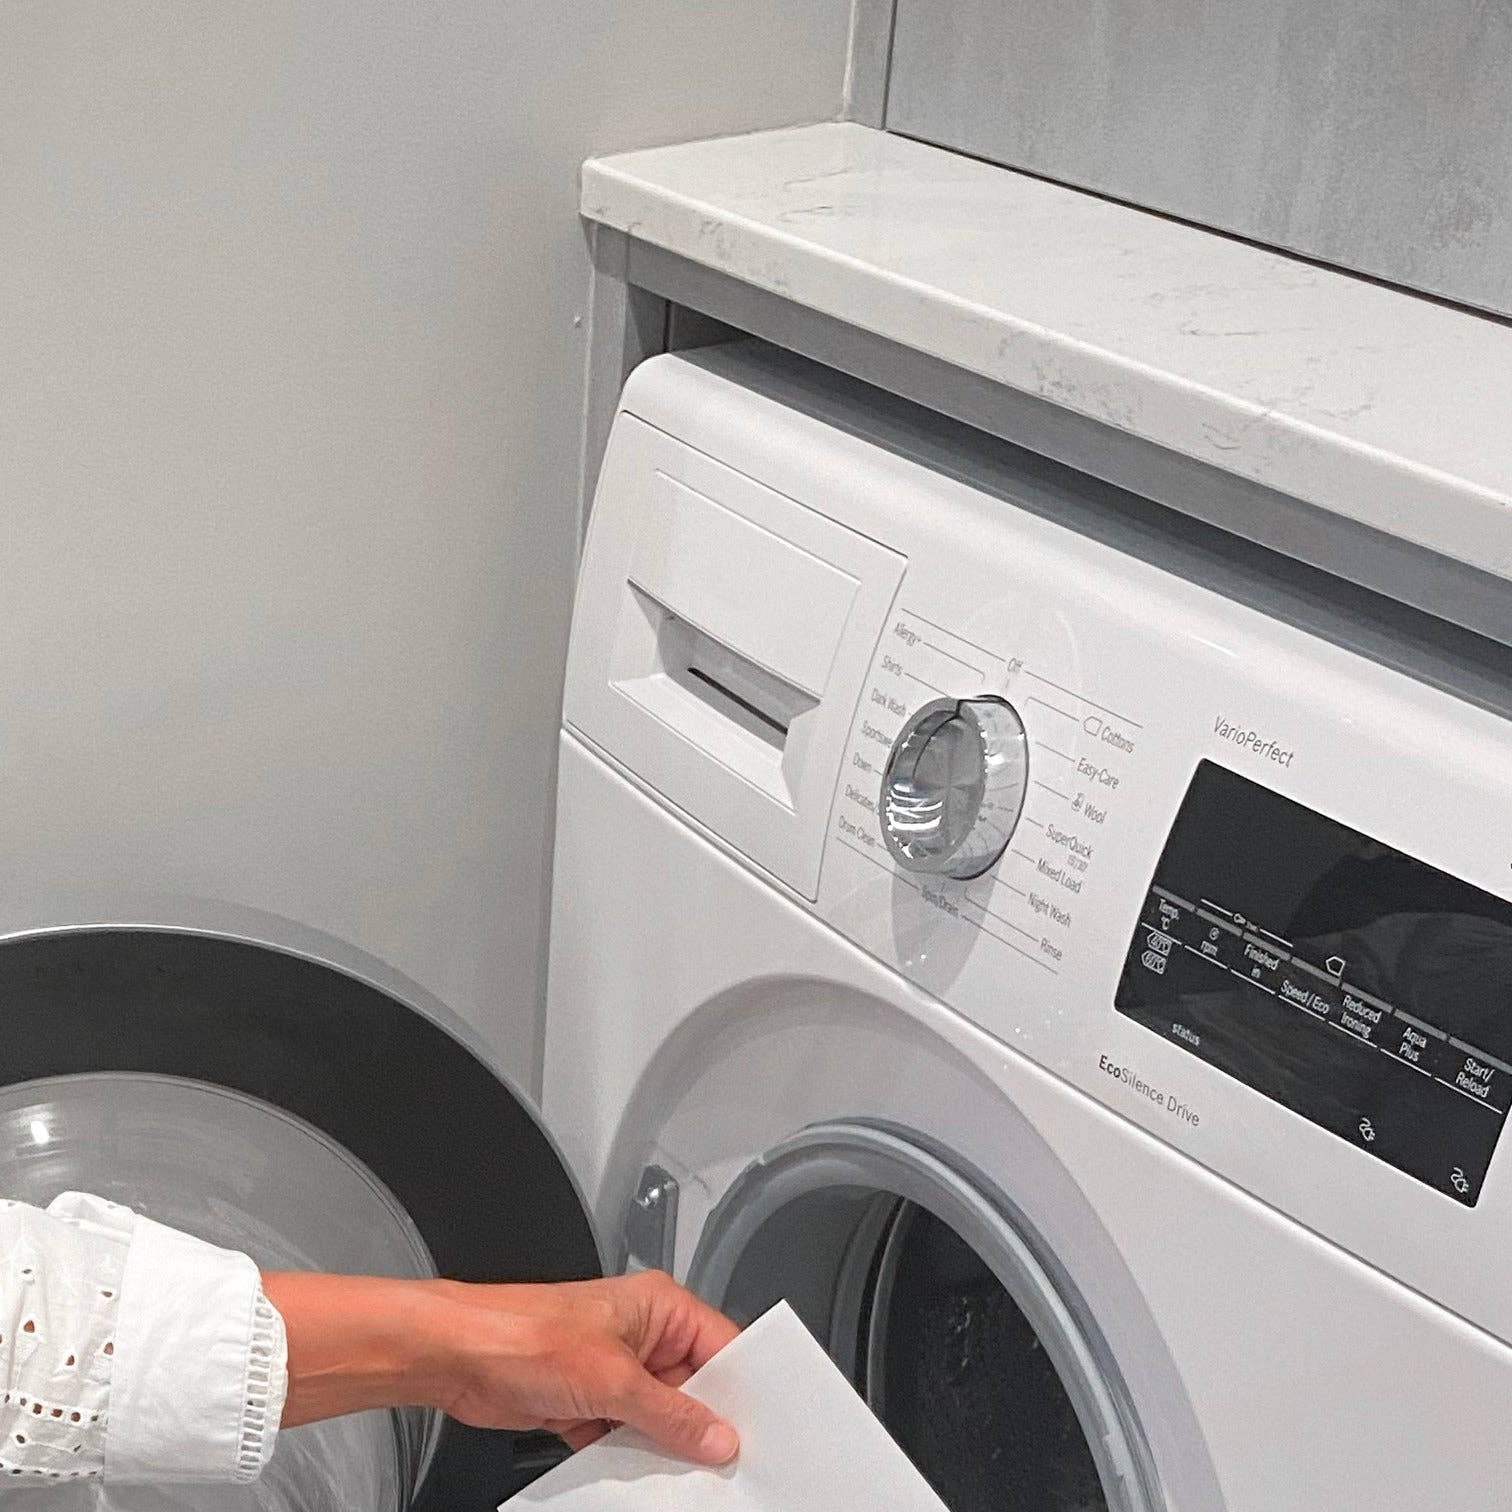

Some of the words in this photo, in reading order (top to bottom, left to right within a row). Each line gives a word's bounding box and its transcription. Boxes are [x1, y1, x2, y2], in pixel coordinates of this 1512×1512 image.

[1101, 726, 1135, 754] Cottons
[1214, 715, 1294, 768] VarioPerfect
[1077, 758, 1120, 789] Easy-Care
[1085, 804, 1107, 824] Wool
[1046, 823, 1094, 858] SuperQuick
[1037, 858, 1061, 882] Mixed
[1061, 873, 1082, 893] Load
[1028, 892, 1049, 917] Night
[1049, 904, 1072, 928] Wash
[1041, 938, 1063, 961] Rinse
[1244, 944, 1279, 971] Finished
[1343, 995, 1382, 1024] Reduced
[1172, 1024, 1200, 1047] status
[1341, 1012, 1372, 1039] Ironing
[1402, 1027, 1427, 1049] Aqua
[1399, 1042, 1419, 1062] Plus
[1099, 1055, 1164, 1105] EcoSilence
[1167, 1096, 1200, 1127] Drive
[1456, 1072, 1491, 1098] Reload
